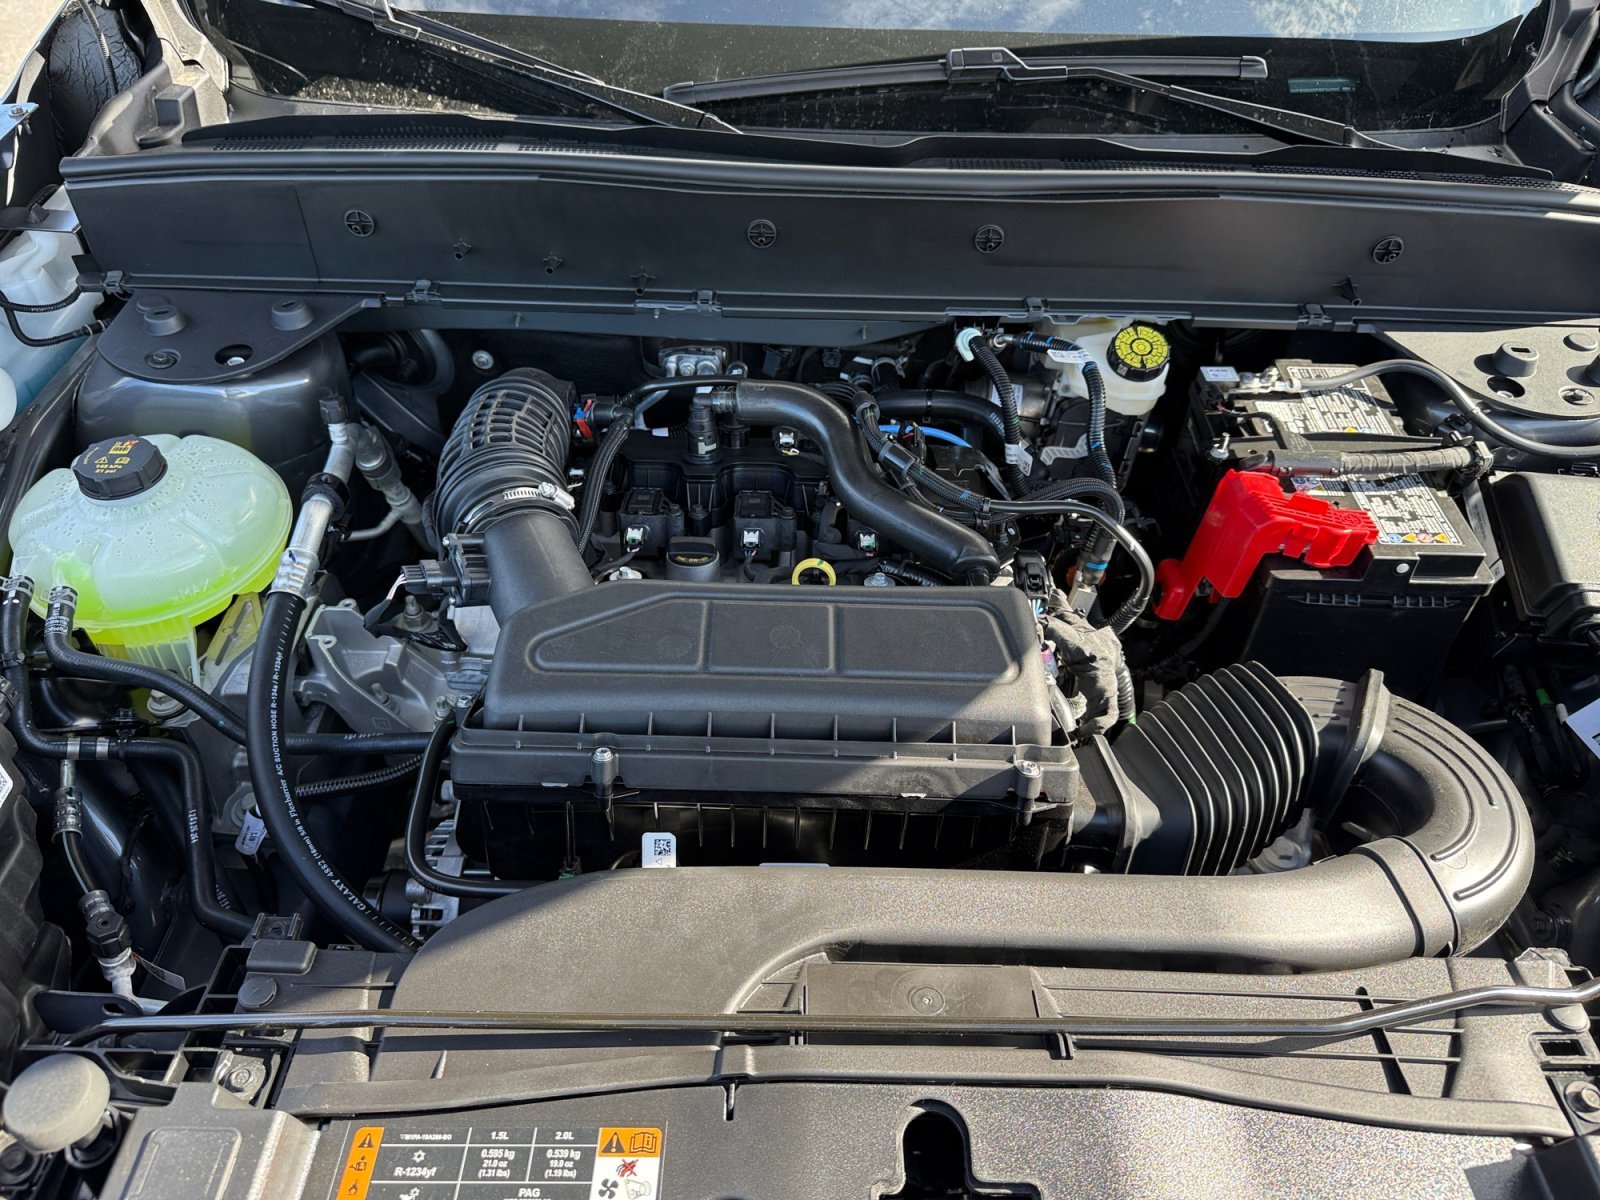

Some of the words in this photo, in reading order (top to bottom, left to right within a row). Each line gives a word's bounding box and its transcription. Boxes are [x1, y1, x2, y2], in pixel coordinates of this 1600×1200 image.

[271, 730, 281, 762] SUCTION
[275, 763, 284, 776] A/C
[280, 779, 298, 818] Flexbarrier
[297, 825, 307, 836] 5/8
[317, 859, 334, 877] 4882
[331, 879, 366, 911] GALAXY
[491, 1131, 509, 1140] 1.5L
[555, 1131, 575, 1140] 2.0L
[480, 1149, 504, 1158] 0.595
[503, 1149, 515, 1160] kg
[546, 1149, 569, 1158] 0.539
[569, 1149, 581, 1160] kg
[482, 1160, 498, 1168] 21.0
[393, 1166, 437, 1178] R-1234yf
[496, 1169, 510, 1178] lbs)
[562, 1169, 577, 1178] lbs)
[518, 1188, 541, 1197] PAG
